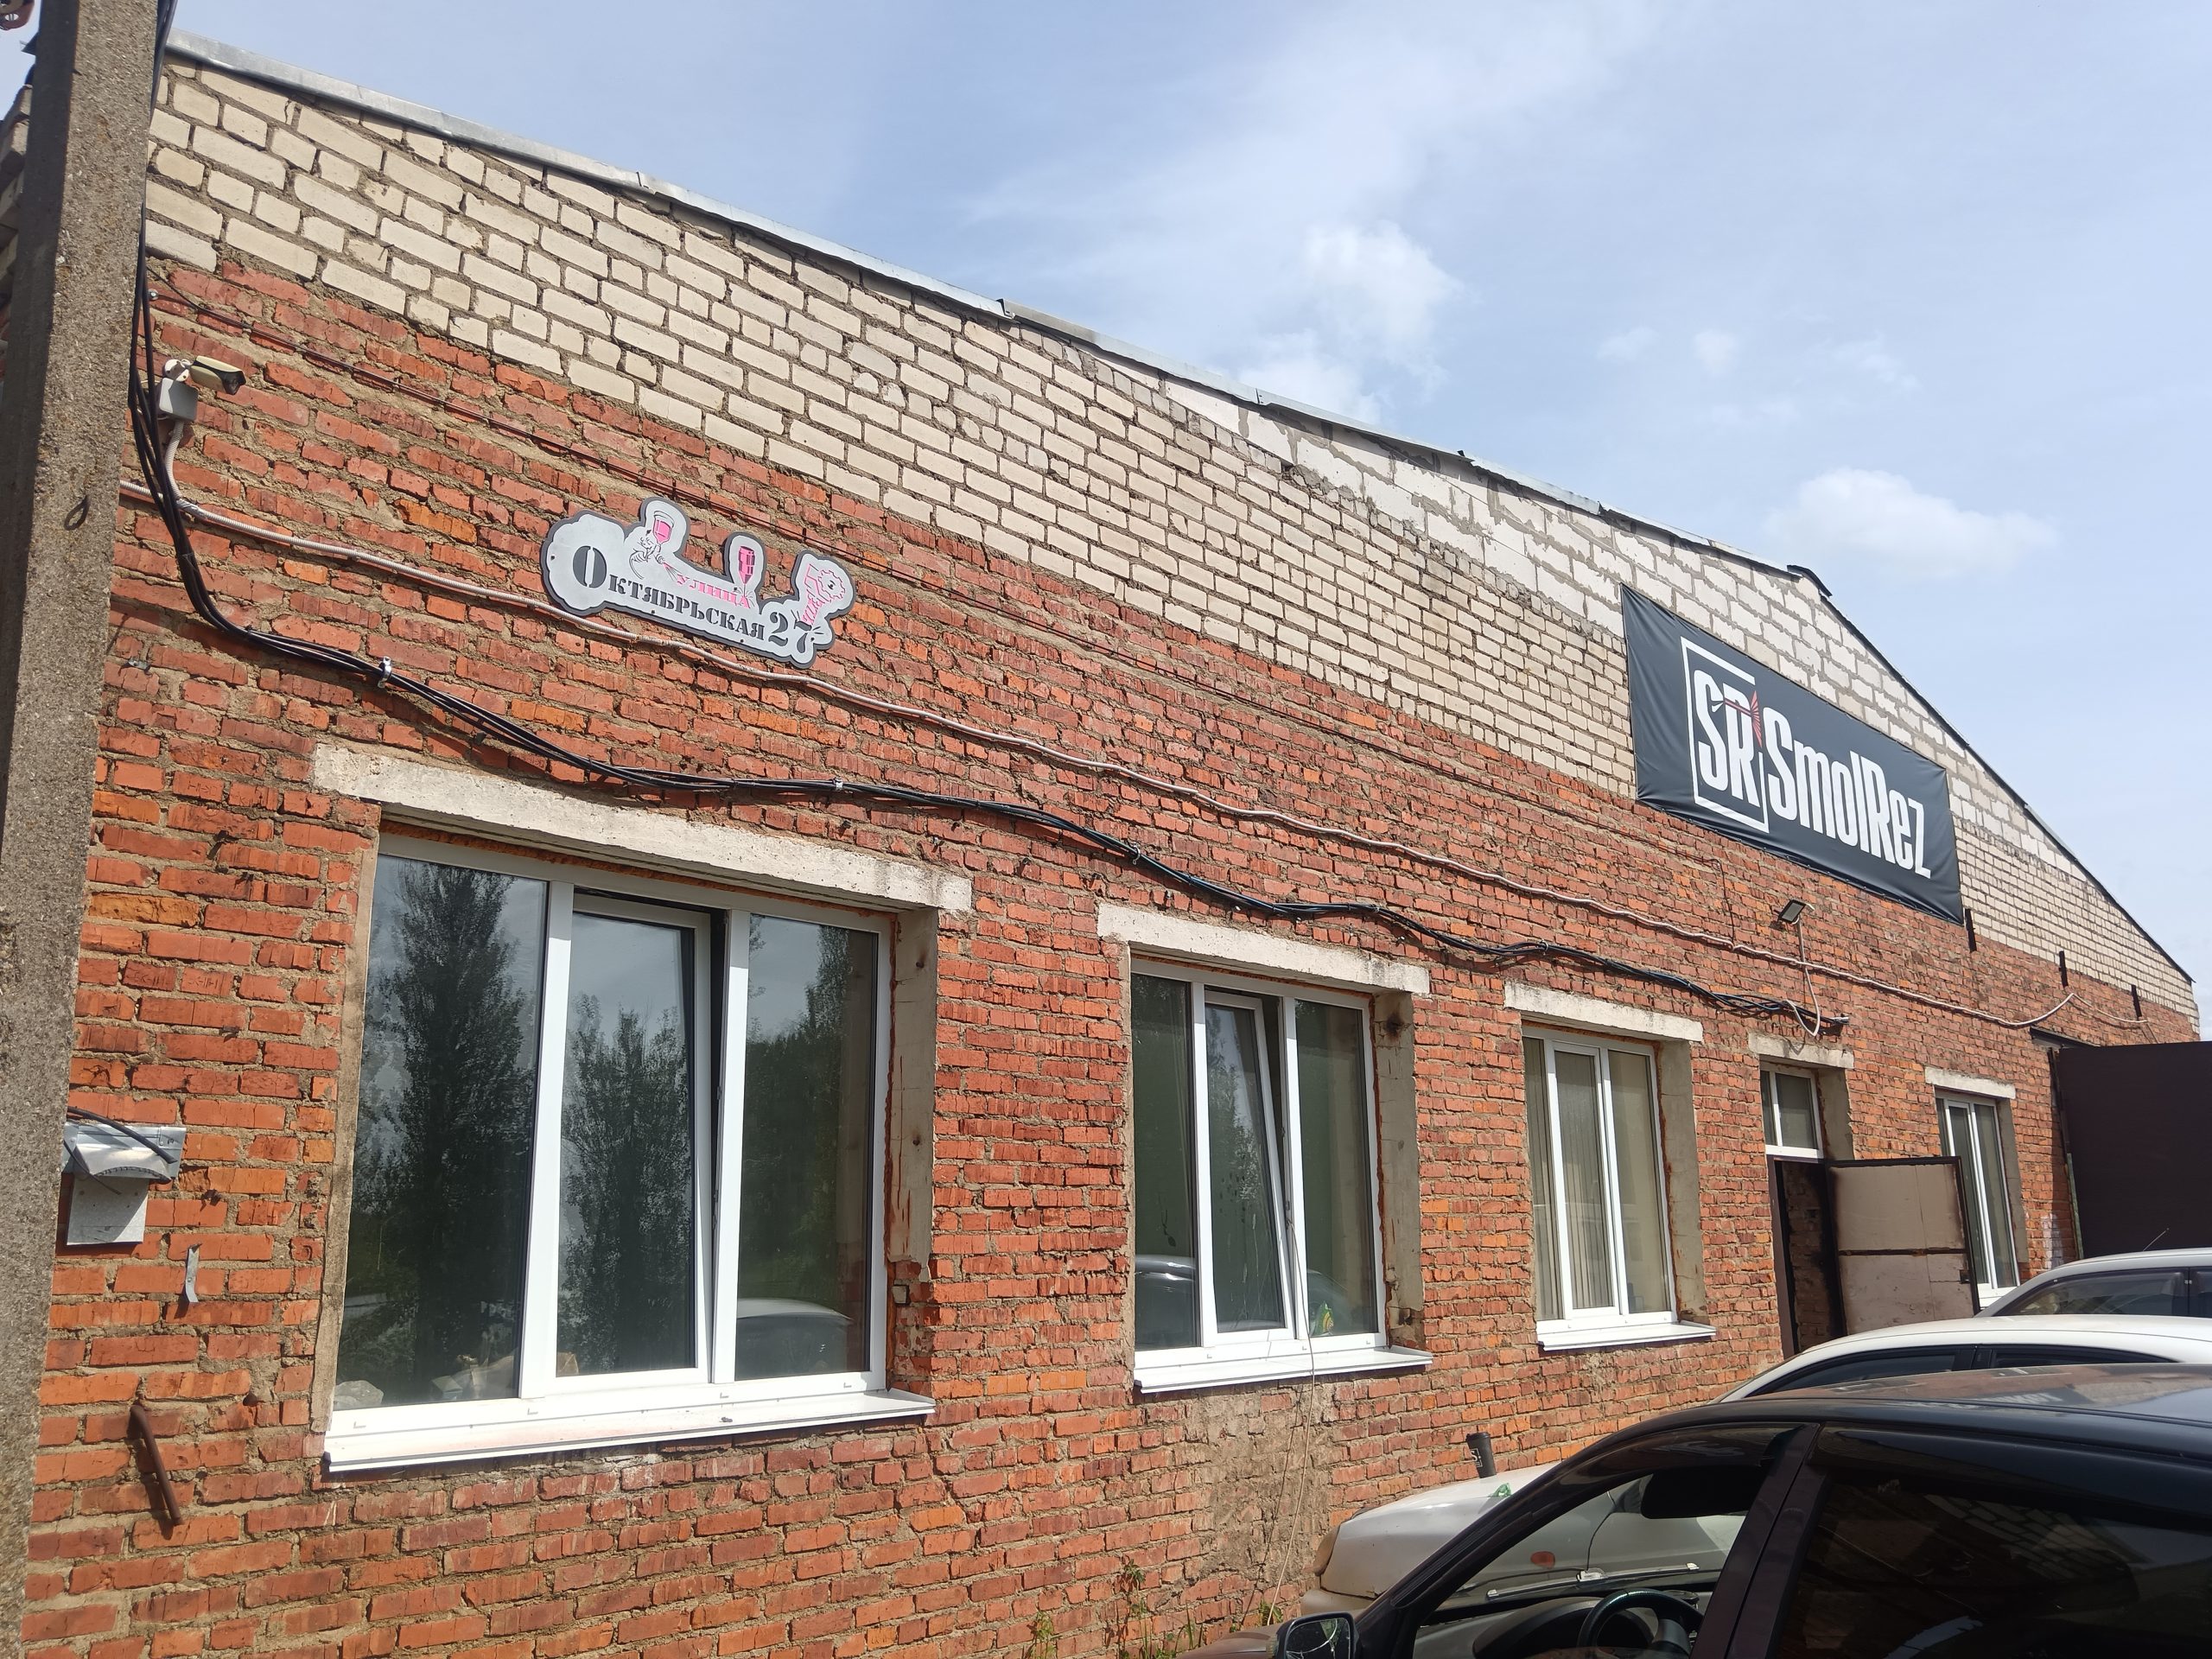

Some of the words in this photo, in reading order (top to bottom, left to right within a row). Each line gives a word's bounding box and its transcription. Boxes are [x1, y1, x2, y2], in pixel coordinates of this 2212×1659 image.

[768, 612, 812, 654] 27
[1694, 670, 1760, 807] SR
[1764, 707, 1931, 878] SmolRez
